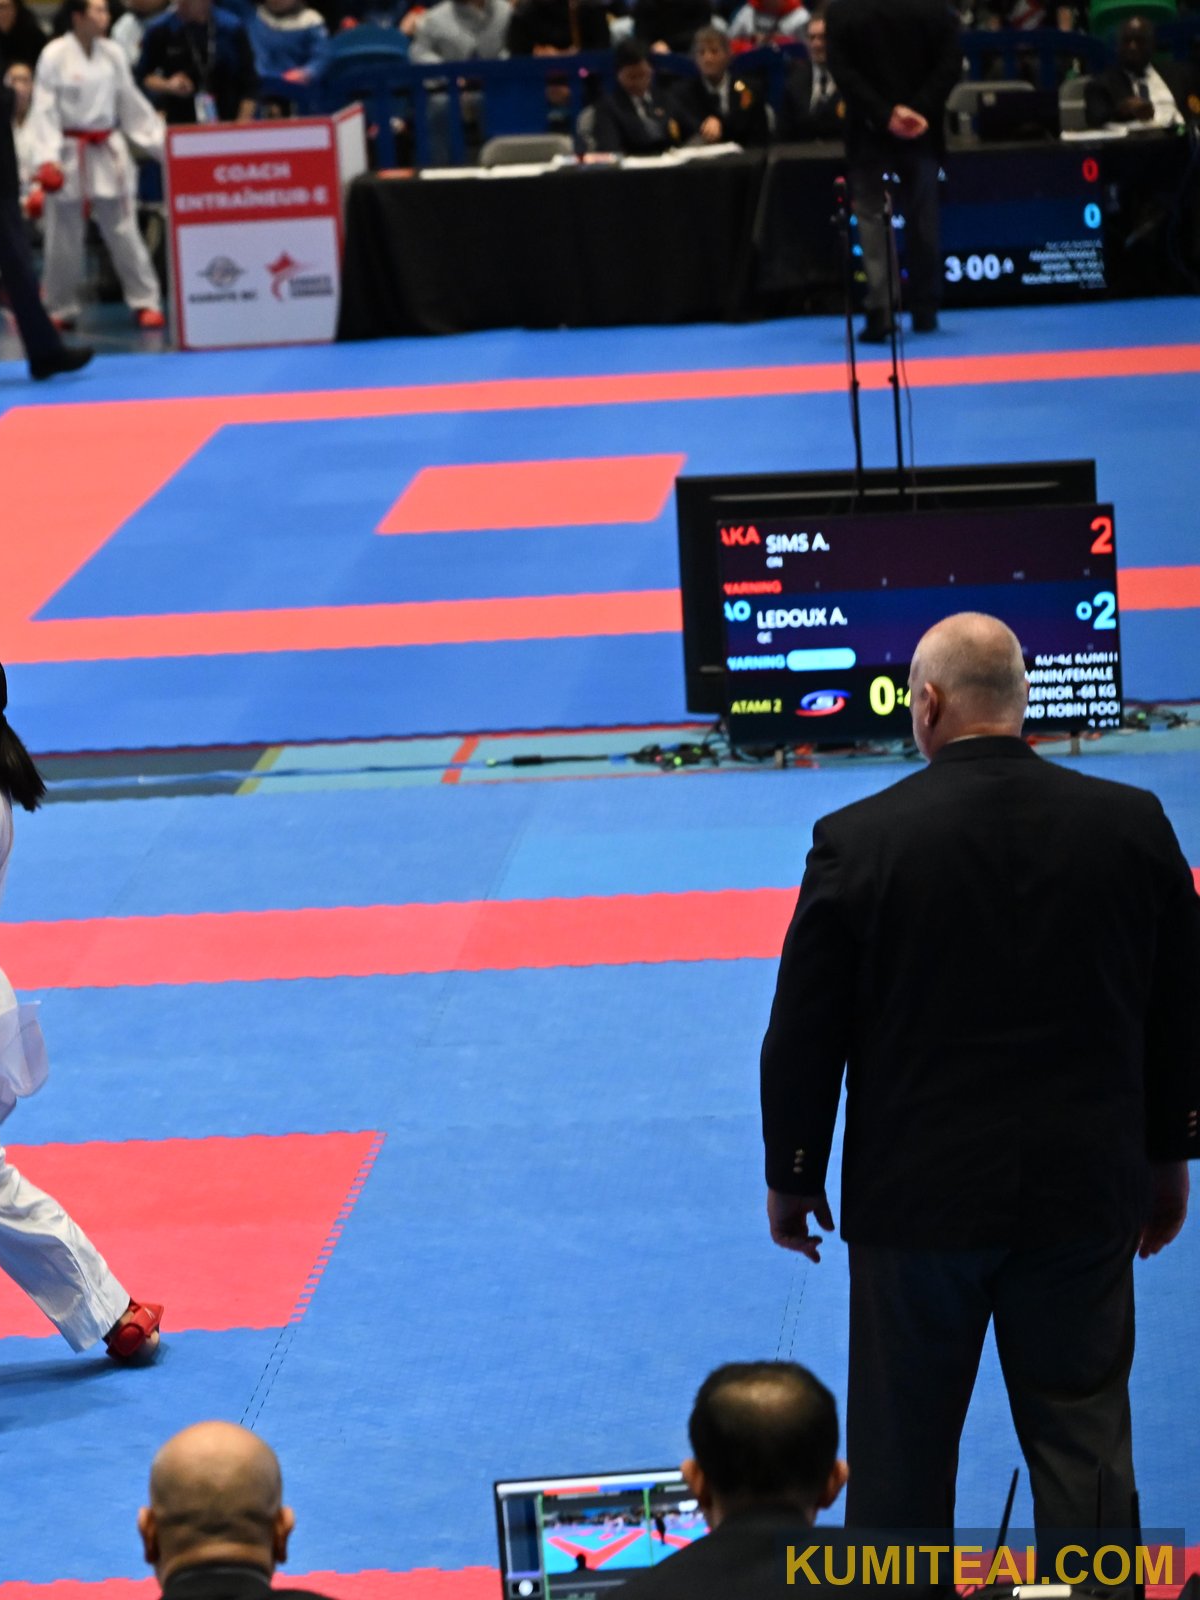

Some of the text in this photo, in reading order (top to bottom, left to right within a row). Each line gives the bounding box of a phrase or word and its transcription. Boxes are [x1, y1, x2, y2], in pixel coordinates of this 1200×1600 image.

[213, 161, 291, 183] COACH
[1082, 157, 1099, 183] 0
[1084, 202, 1101, 229] 0
[766, 532, 809, 554] SIMS
[812, 532, 830, 551] A.
[1090, 516, 1112, 554] 2
[757, 607, 827, 629] LEDOUX
[830, 607, 848, 626] A.
[869, 675, 911, 716] 0:
[1098, 683, 1116, 698] KG
[1047, 702, 1087, 718] ROBIN
